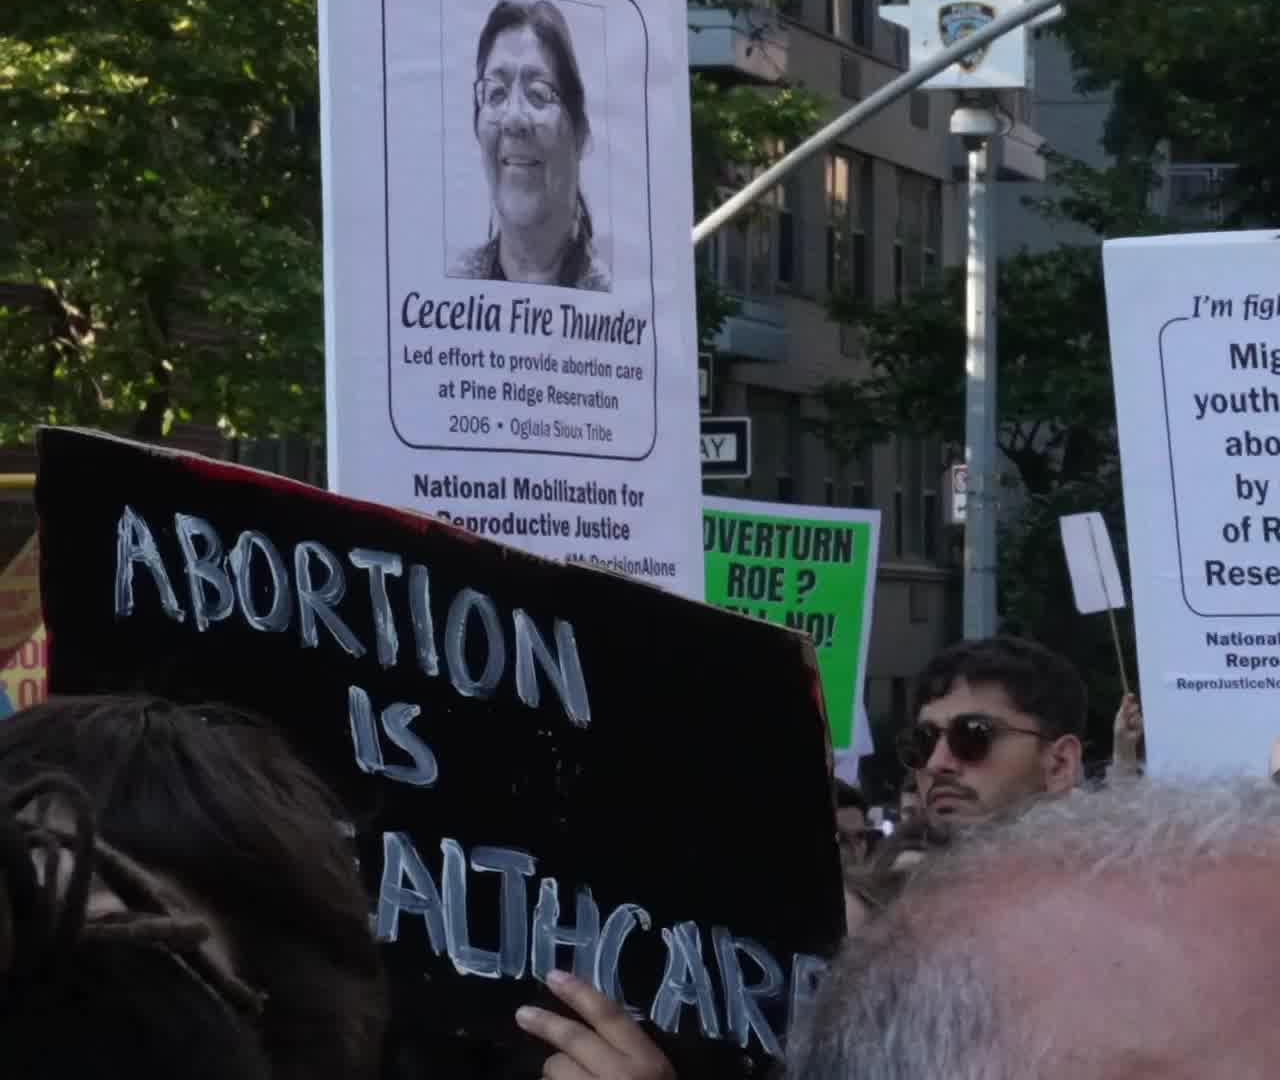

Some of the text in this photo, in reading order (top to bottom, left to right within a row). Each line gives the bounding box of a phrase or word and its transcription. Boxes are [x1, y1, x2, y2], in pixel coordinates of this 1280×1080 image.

[401, 291, 647, 345] Cecelia Fire Thunder
[1192, 294, 1233, 318] I'm
[403, 345, 643, 381] Led effort to provide abortion care
[438, 380, 619, 409] at Pine Ridge Reservation
[1194, 387, 1279, 420] youth
[449, 415, 613, 442] 2006 Oglala Sioux Tribe
[413, 474, 645, 508] National Mobilization for
[1235, 473, 1270, 506] by
[574, 517, 631, 541] Justice
[1222, 516, 1251, 543] of
[727, 563, 785, 602] ROE
[115, 504, 592, 730] ABORTION
[347, 684, 439, 786] IS
